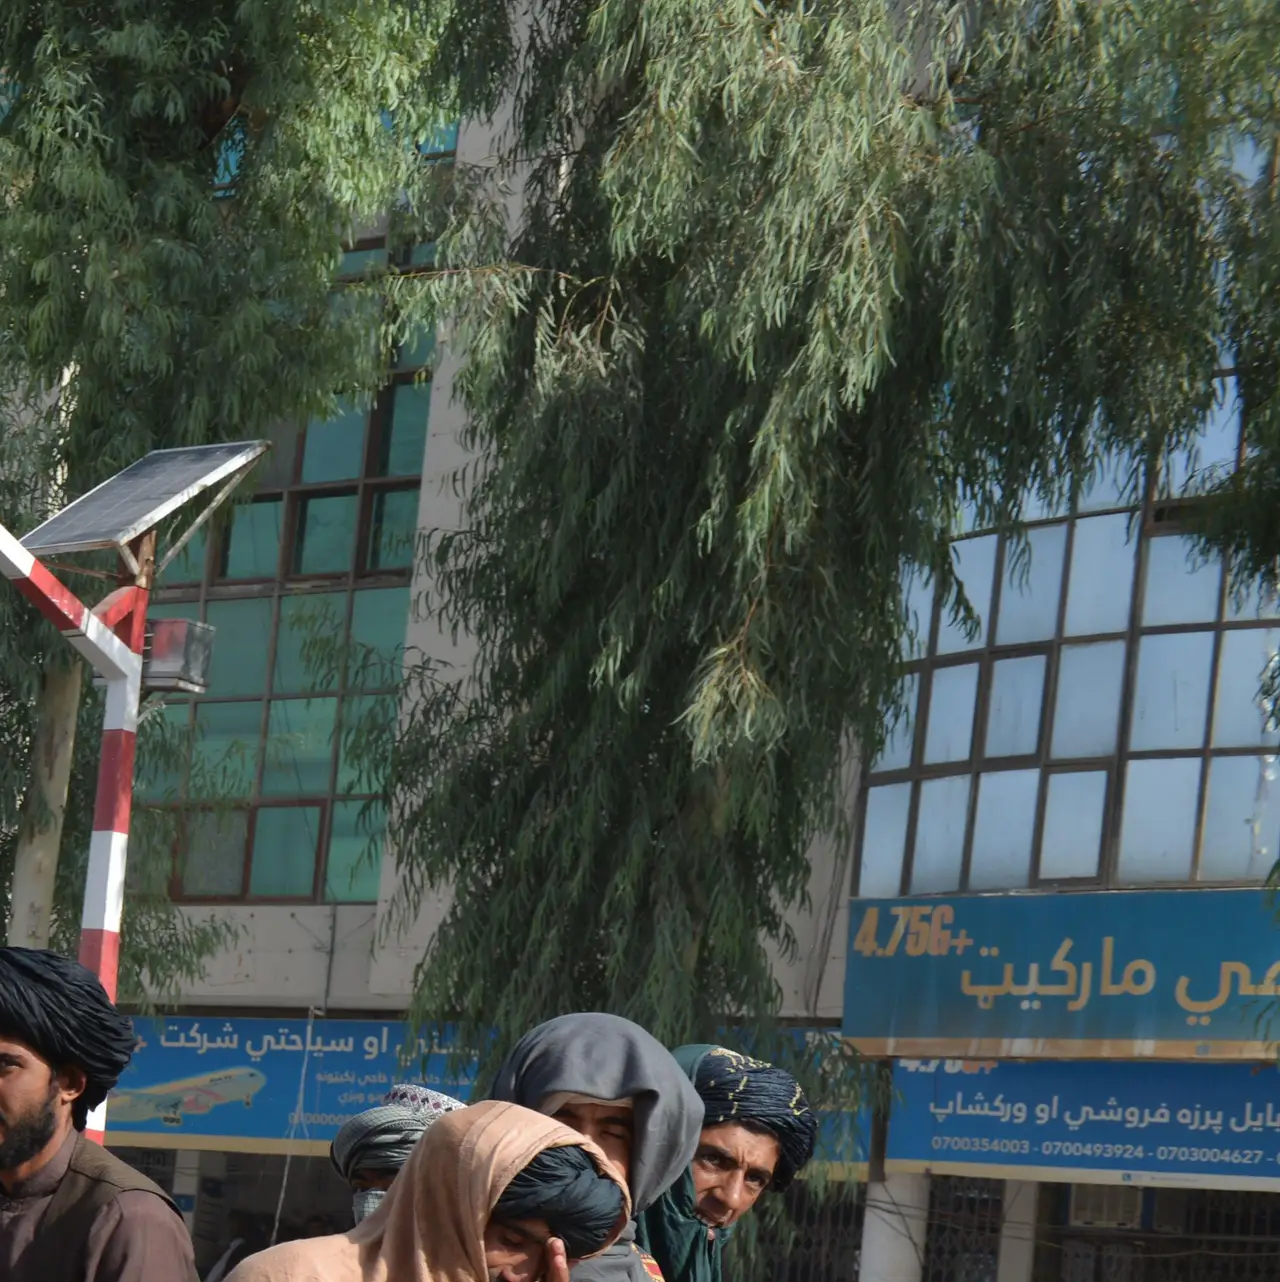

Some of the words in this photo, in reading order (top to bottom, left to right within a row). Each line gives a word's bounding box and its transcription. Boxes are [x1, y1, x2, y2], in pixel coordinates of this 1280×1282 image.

[853, 905, 973, 957] 4.75G+
[160, 1021, 238, 1054] شرکت
[364, 1026, 388, 1060] او
[929, 1091, 1027, 1124] ورکشاپ
[1034, 1095, 1059, 1124] او
[1176, 1104, 1223, 1134] پرزه
[931, 1136, 1030, 1154] 0700354003
[1041, 1141, 1143, 1159] 0700493924
[1157, 1146, 1263, 1164] 0703004627
